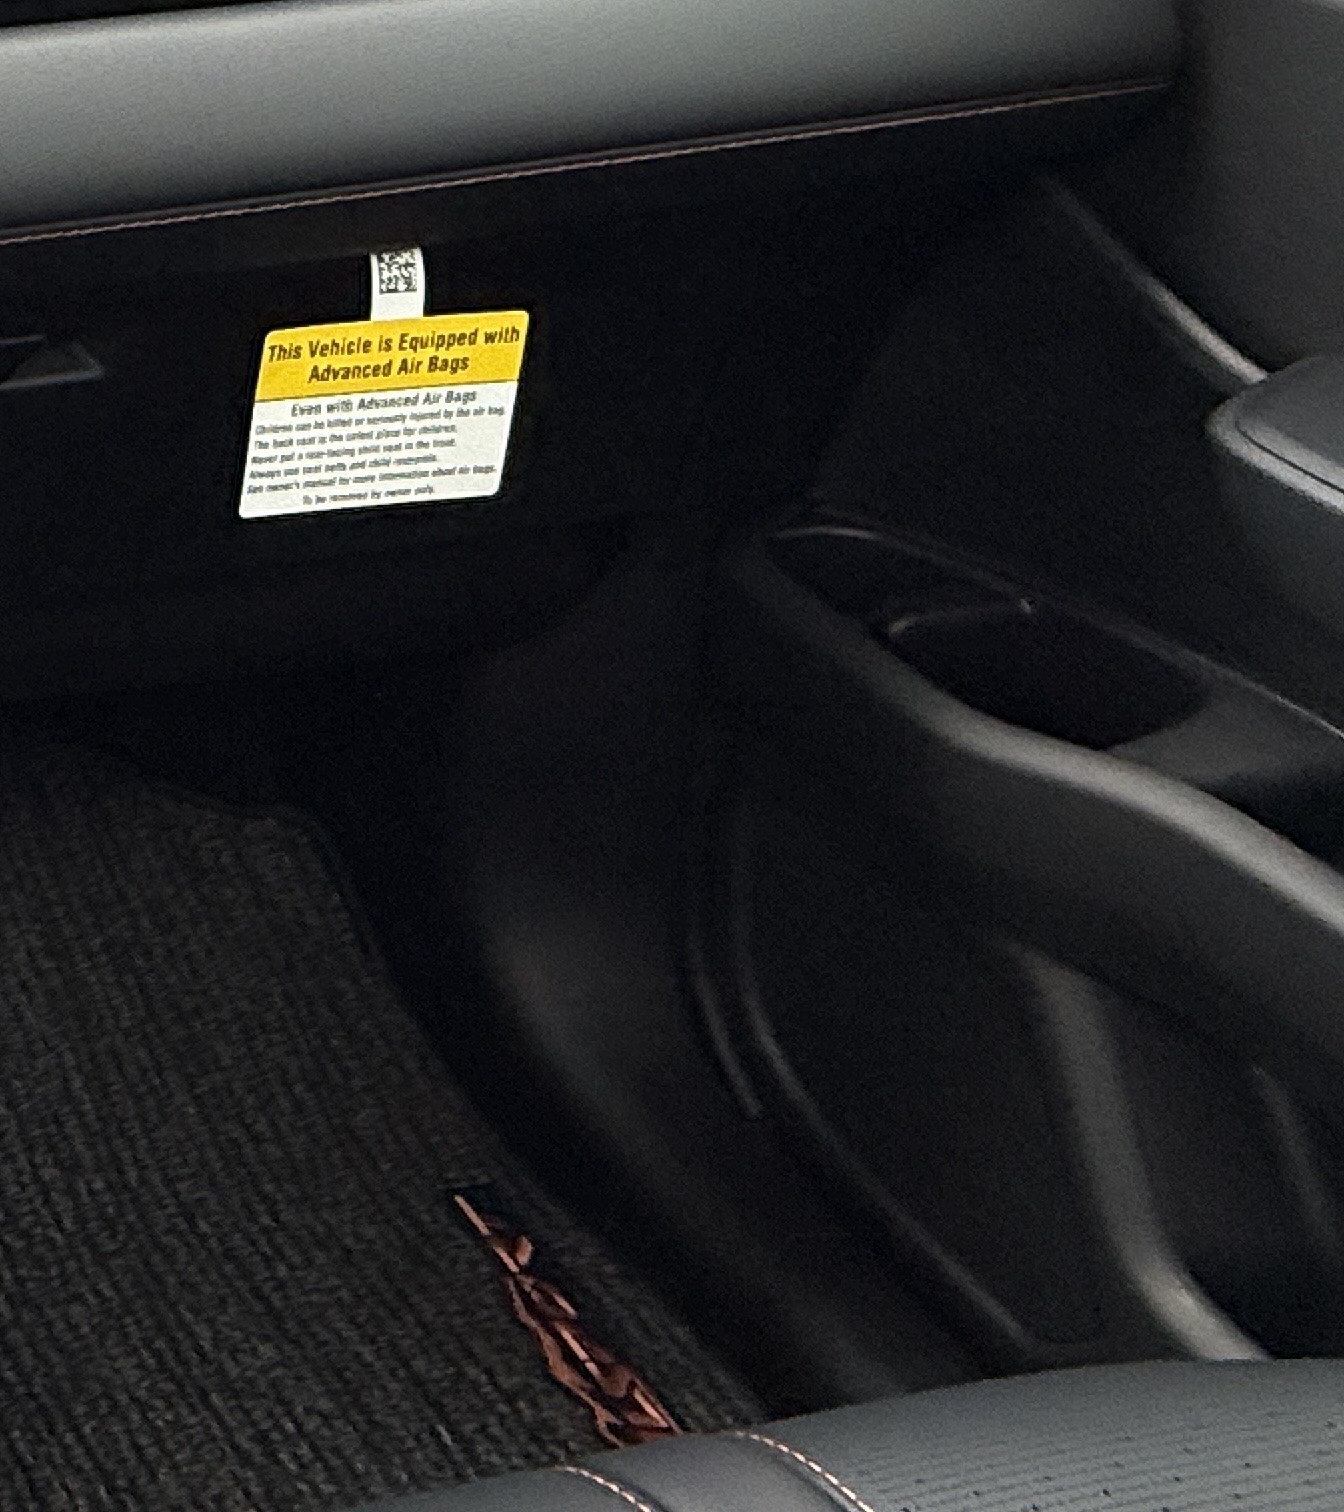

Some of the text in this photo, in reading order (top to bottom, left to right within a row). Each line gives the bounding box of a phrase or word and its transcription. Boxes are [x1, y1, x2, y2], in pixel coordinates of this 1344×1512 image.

[268, 325, 520, 363] This Vehicle is Equipped with
[307, 354, 470, 384] Advanced Air Bags
[291, 390, 477, 417] Even with Advanced Air Bags
